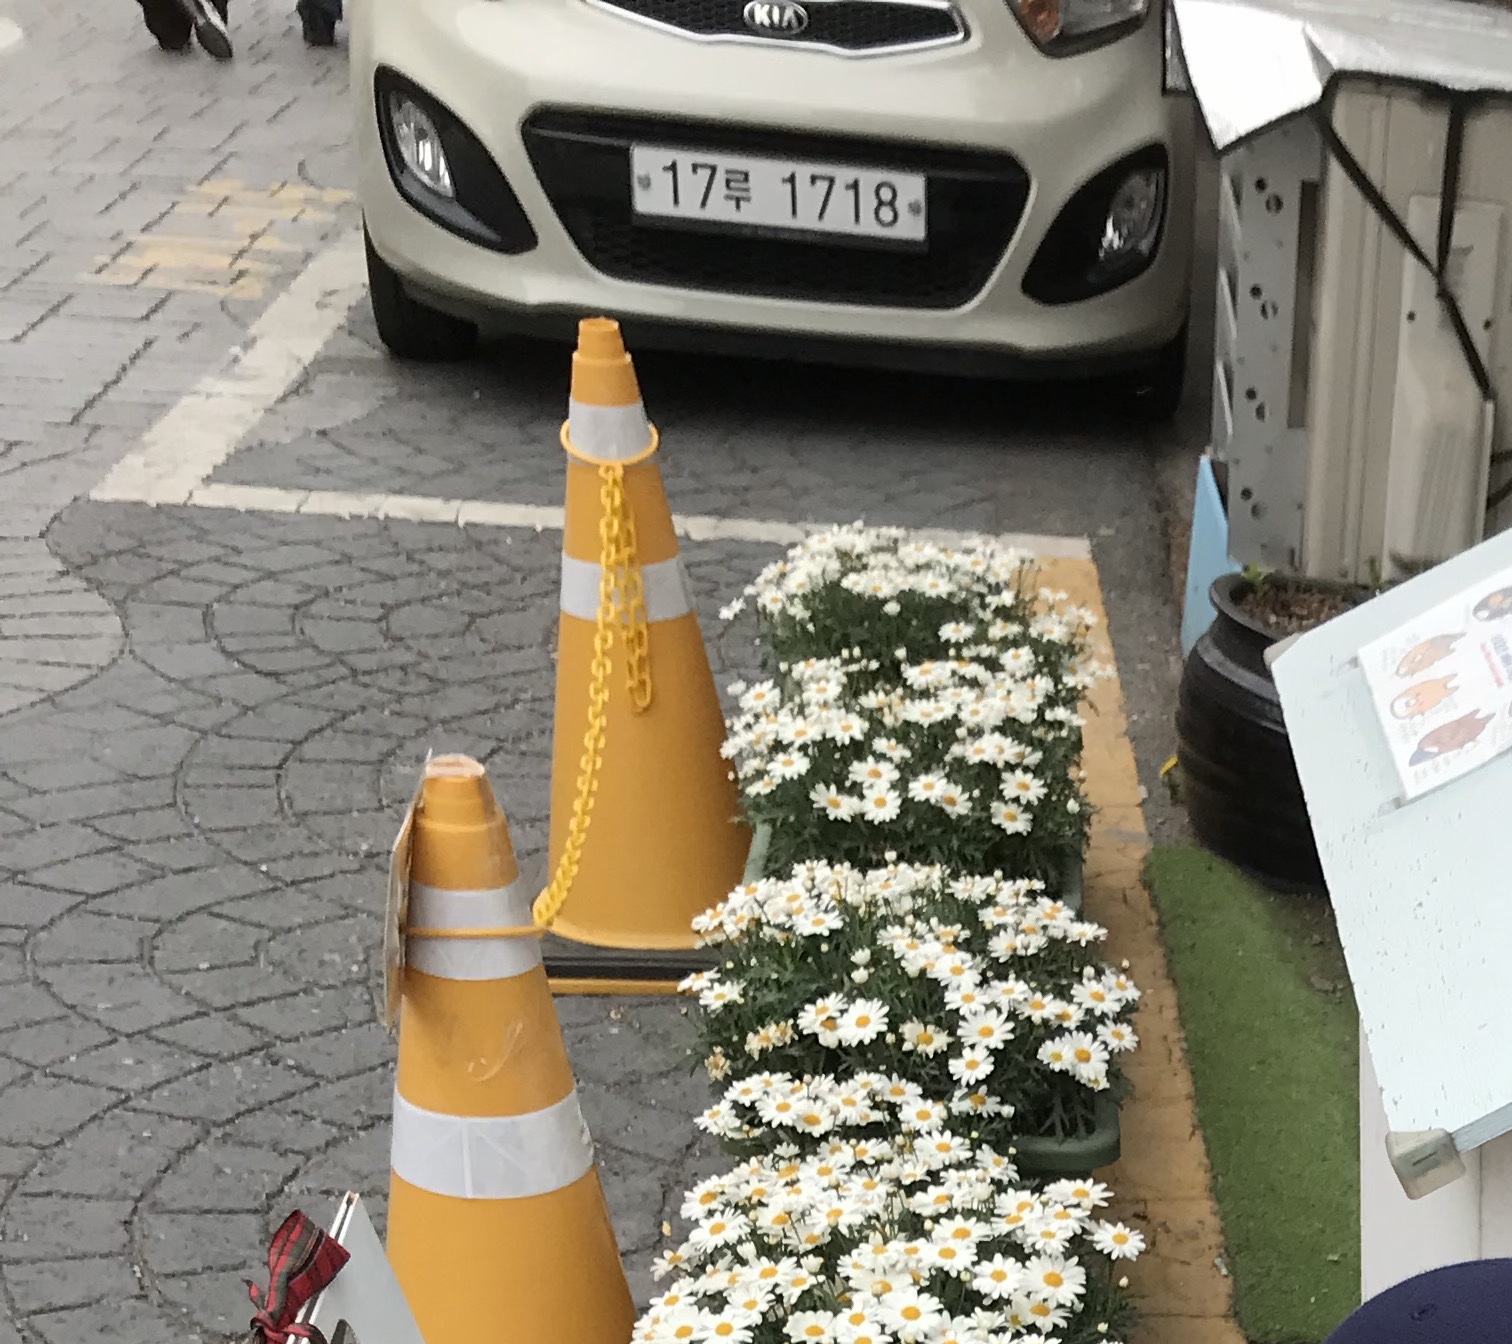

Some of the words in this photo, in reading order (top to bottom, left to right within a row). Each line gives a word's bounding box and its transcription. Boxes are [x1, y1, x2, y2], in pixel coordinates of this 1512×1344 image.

[753, 3, 798, 29] KIA
[662, 159, 752, 212] 17루
[782, 171, 900, 228] 1718
